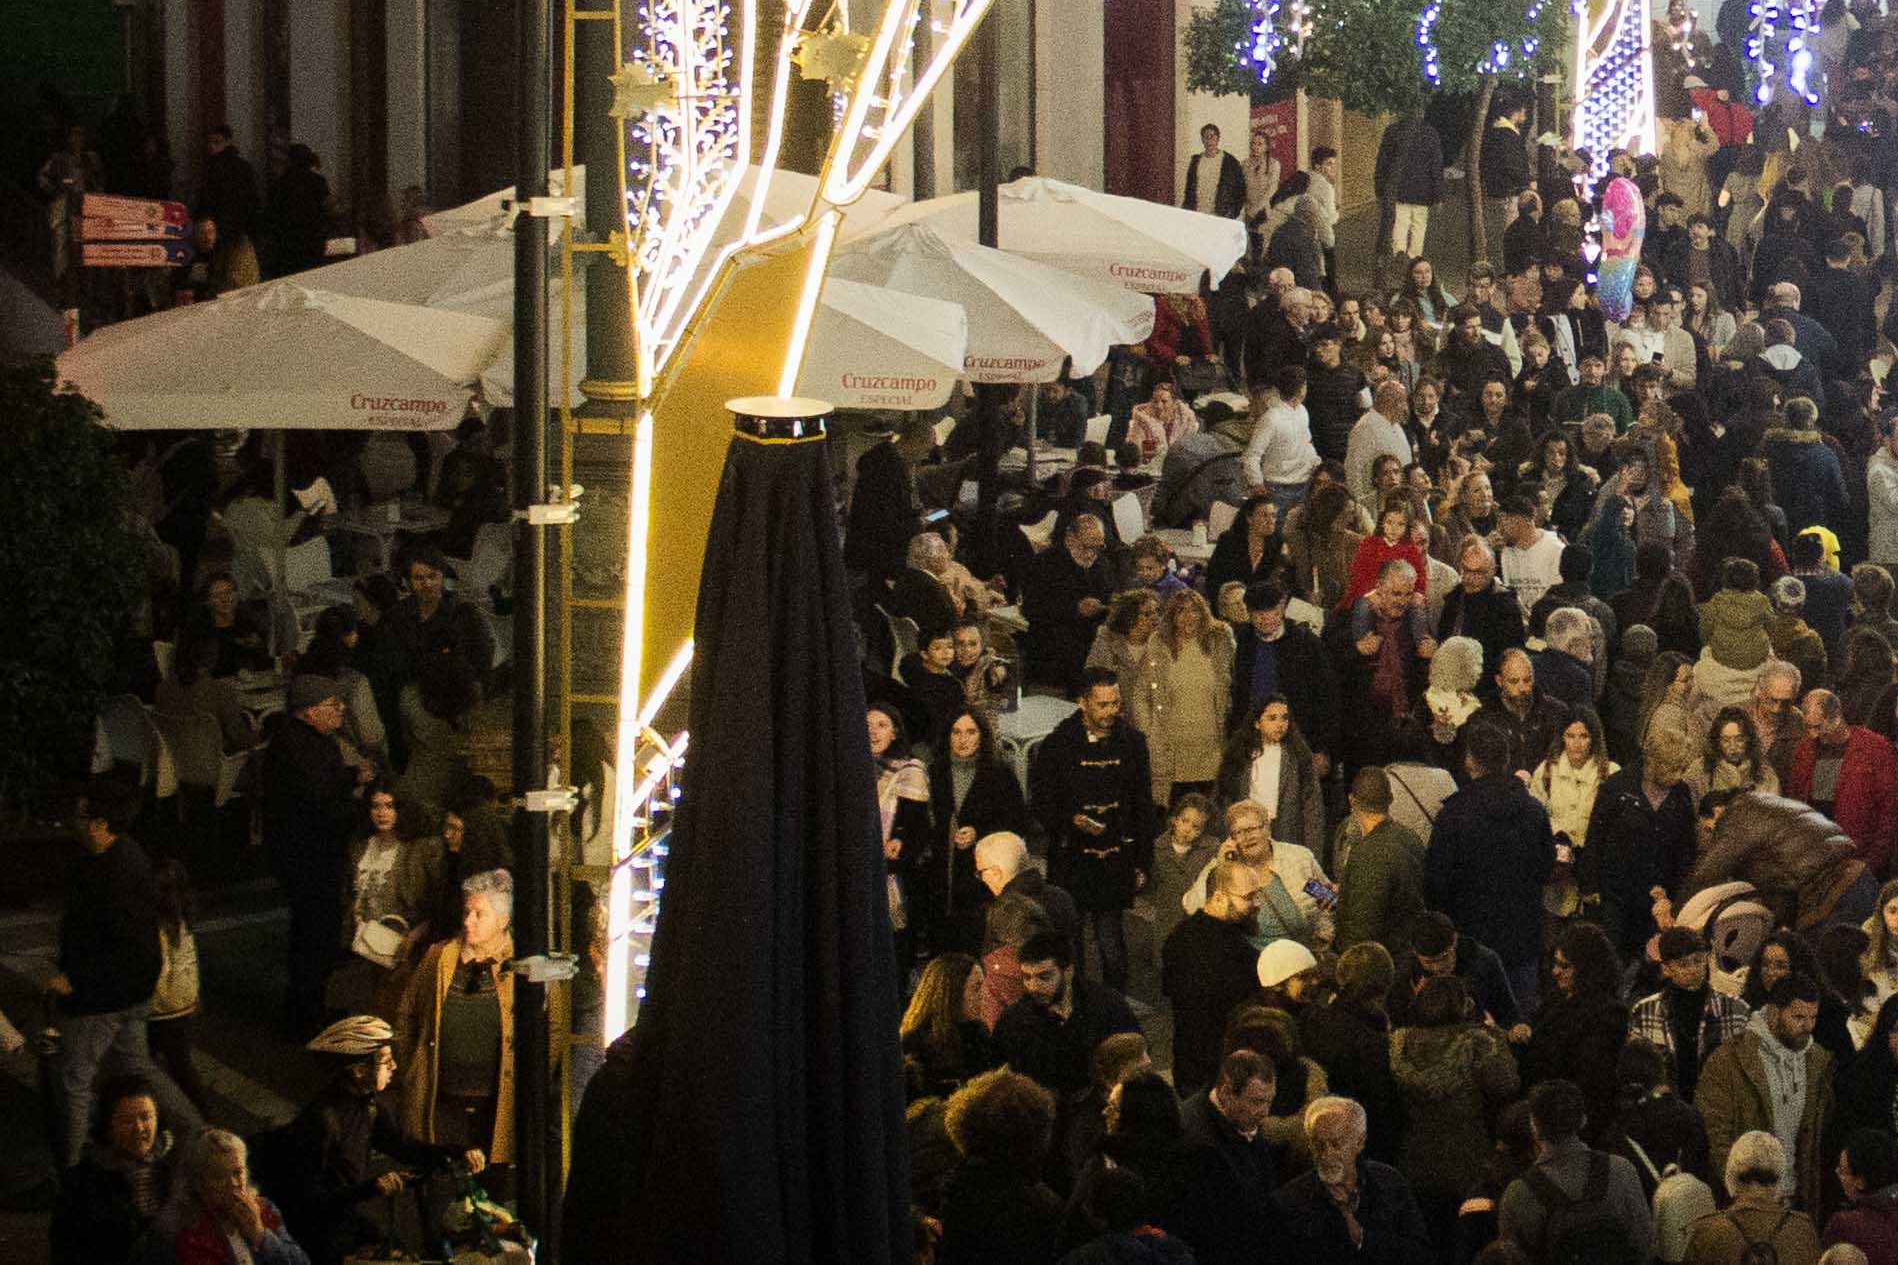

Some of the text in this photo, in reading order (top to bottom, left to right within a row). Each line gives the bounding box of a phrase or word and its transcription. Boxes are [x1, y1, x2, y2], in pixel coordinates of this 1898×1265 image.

[1109, 262, 1186, 282] Cruzcampo
[964, 355, 1046, 371] Cruzcampo
[841, 372, 937, 392] Cruzcampo
[350, 393, 448, 415] Cruzcampo
